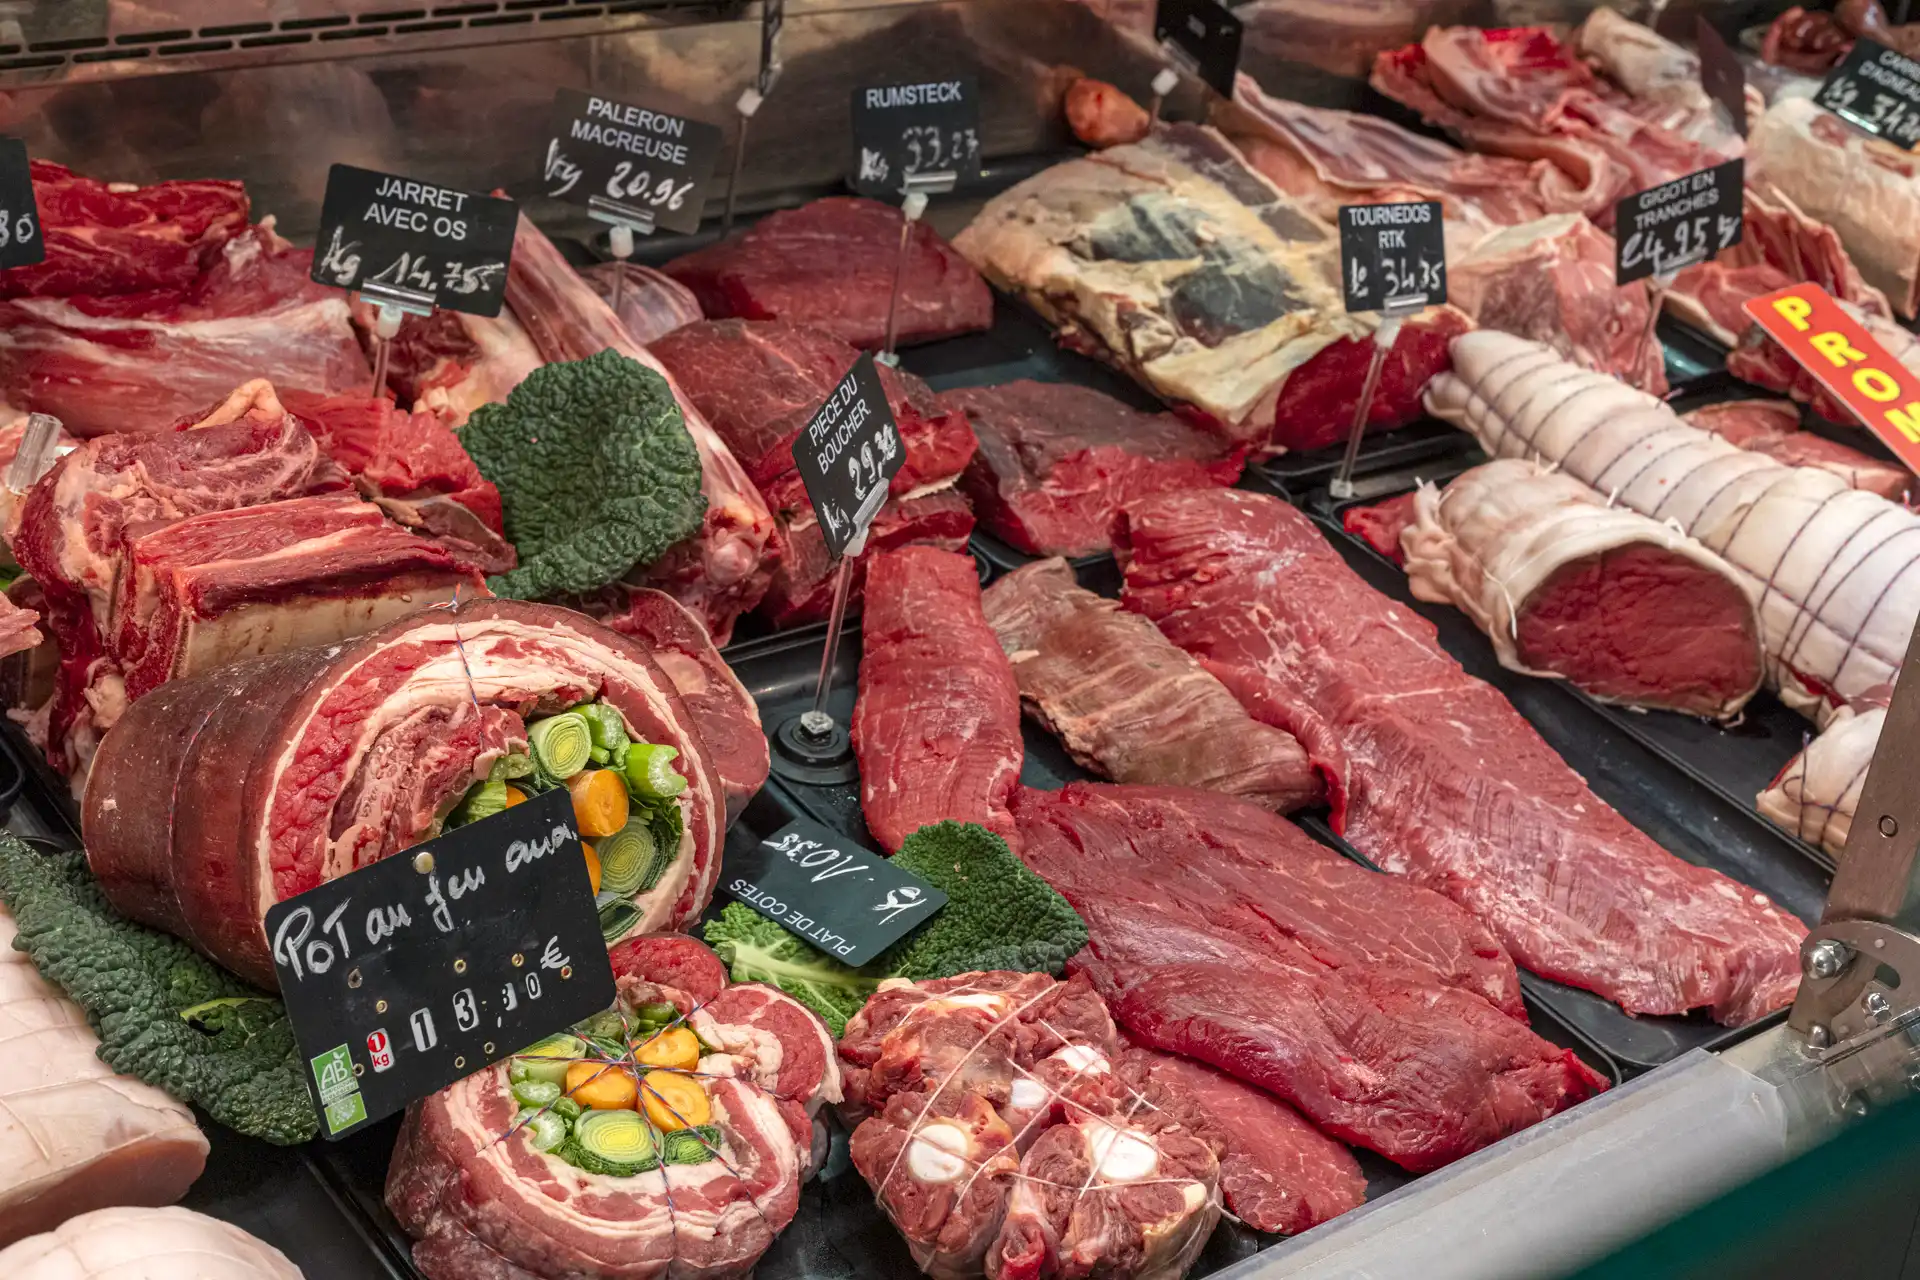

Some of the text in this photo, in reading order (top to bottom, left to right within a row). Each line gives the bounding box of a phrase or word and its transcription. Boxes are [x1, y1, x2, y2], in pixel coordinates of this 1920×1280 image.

[866, 81, 962, 109] RUMSTECK
[586, 97, 685, 137] PALERON
[570, 119, 688, 165] MACREUSE
[376, 178, 468, 212] JARRET
[1634, 188, 1719, 229] TRANCHES
[1639, 170, 1715, 209] GIGOT EN
[363, 203, 467, 241] AVEC OS
[1348, 204, 1431, 226] TOURNEDOS
[1378, 229, 1406, 249] RTK
[809, 373, 858, 447] PIECE DU
[817, 398, 871, 475] BOUCHER
[366, 903, 412, 944] au
[729, 879, 857, 956] PLAT DE COTES
[321, 1060, 348, 1089] AB
